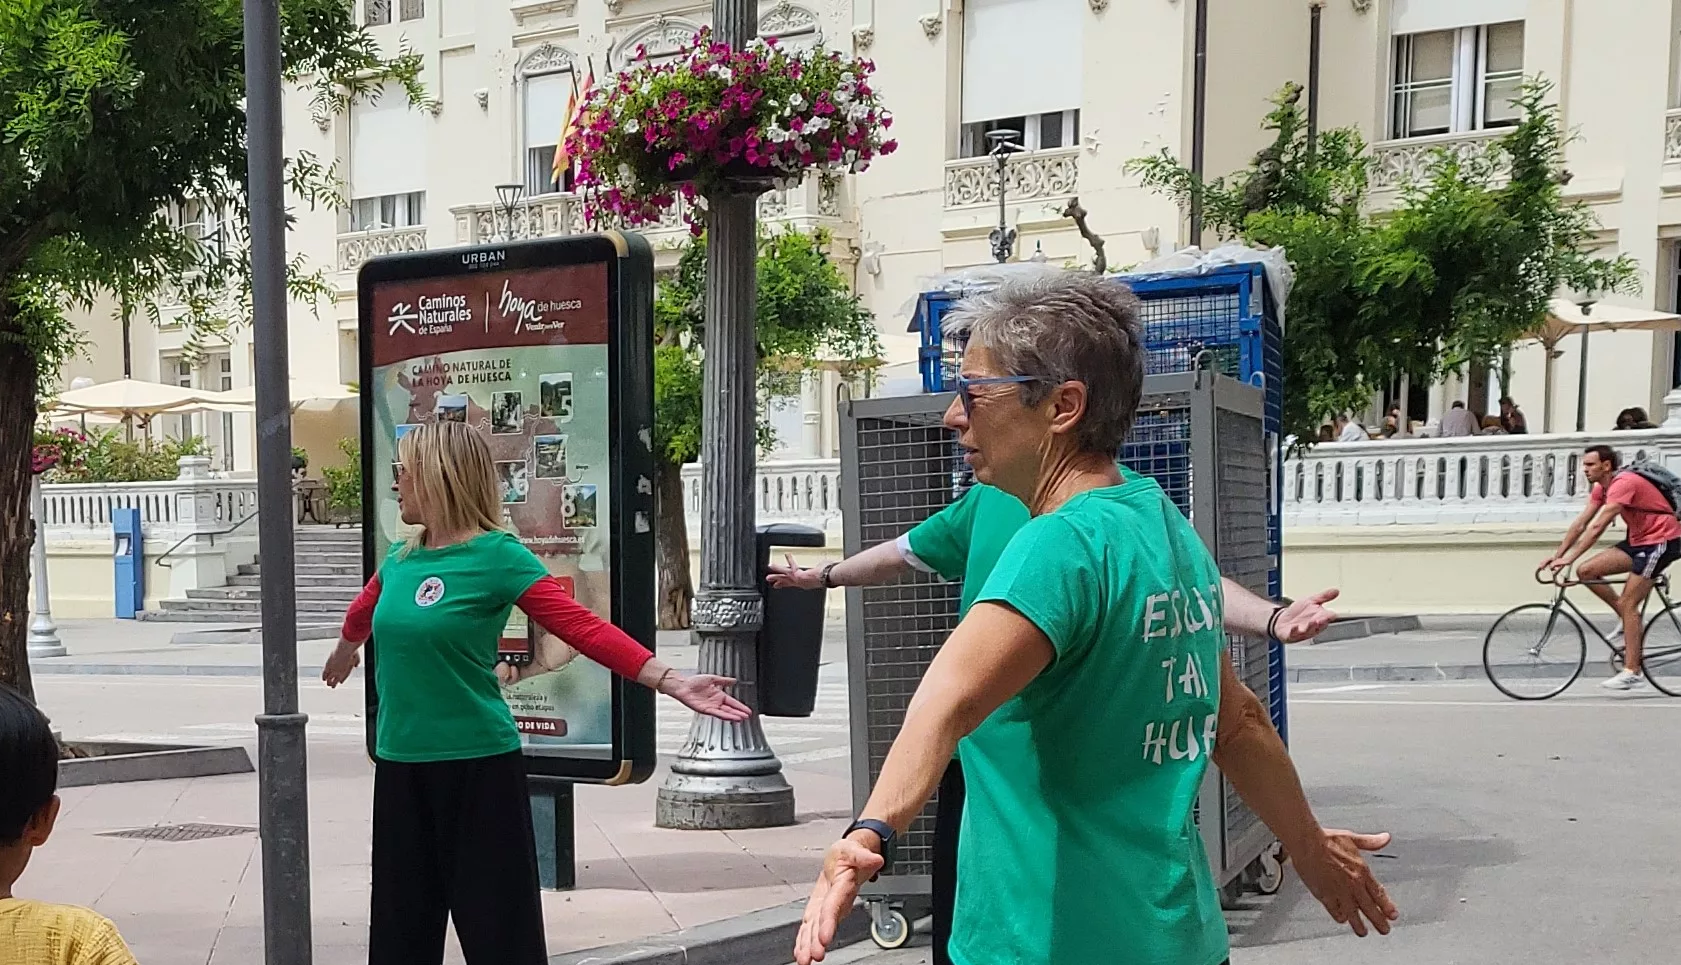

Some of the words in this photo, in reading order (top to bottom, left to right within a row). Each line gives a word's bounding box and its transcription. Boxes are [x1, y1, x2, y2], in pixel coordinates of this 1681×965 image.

[462, 250, 505, 264] URBAN
[418, 293, 467, 311] Caminos
[498, 279, 543, 335] hoya
[537, 301, 549, 313] de
[550, 299, 583, 312] huesca
[418, 306, 473, 326] Naturales
[418, 325, 428, 336] de
[429, 323, 453, 336] España
[412, 362, 450, 376] CAMINO
[452, 359, 497, 374] NATURAL
[499, 358, 512, 370] DE
[412, 377, 425, 387] LA
[426, 374, 454, 386] HOYA
[457, 373, 470, 385] DE
[472, 371, 512, 384] HUESCA
[525, 721, 535, 730] DE
[536, 722, 555, 730] VIDA
